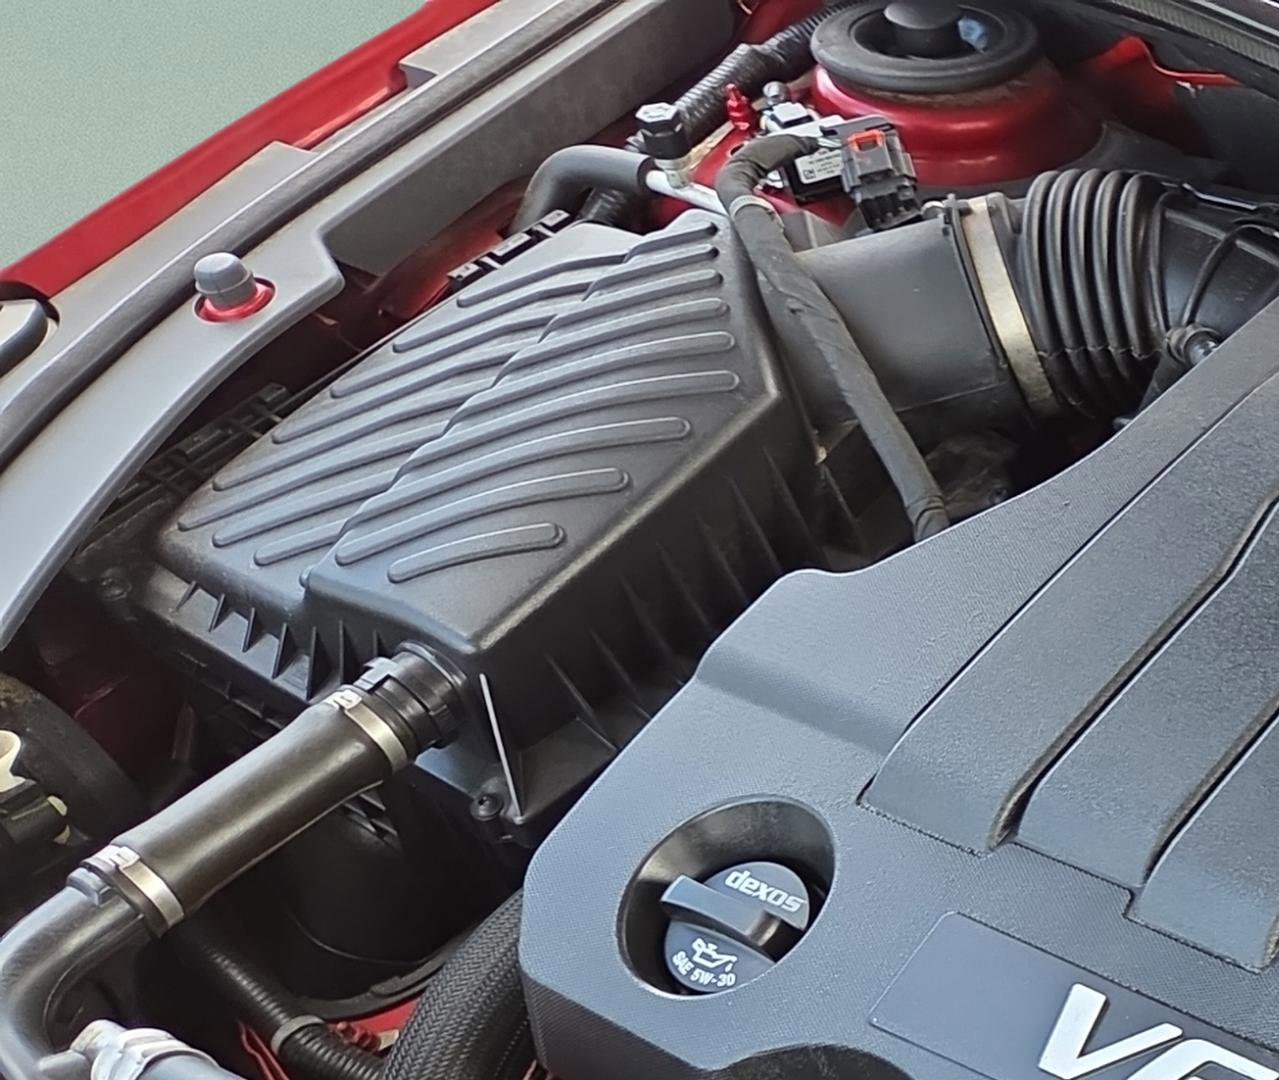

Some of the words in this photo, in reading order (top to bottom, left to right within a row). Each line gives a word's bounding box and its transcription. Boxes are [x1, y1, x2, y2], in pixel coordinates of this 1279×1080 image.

[725, 870, 806, 912] dexos
[672, 951, 693, 976] SAE
[690, 968, 736, 987] 5W-30
